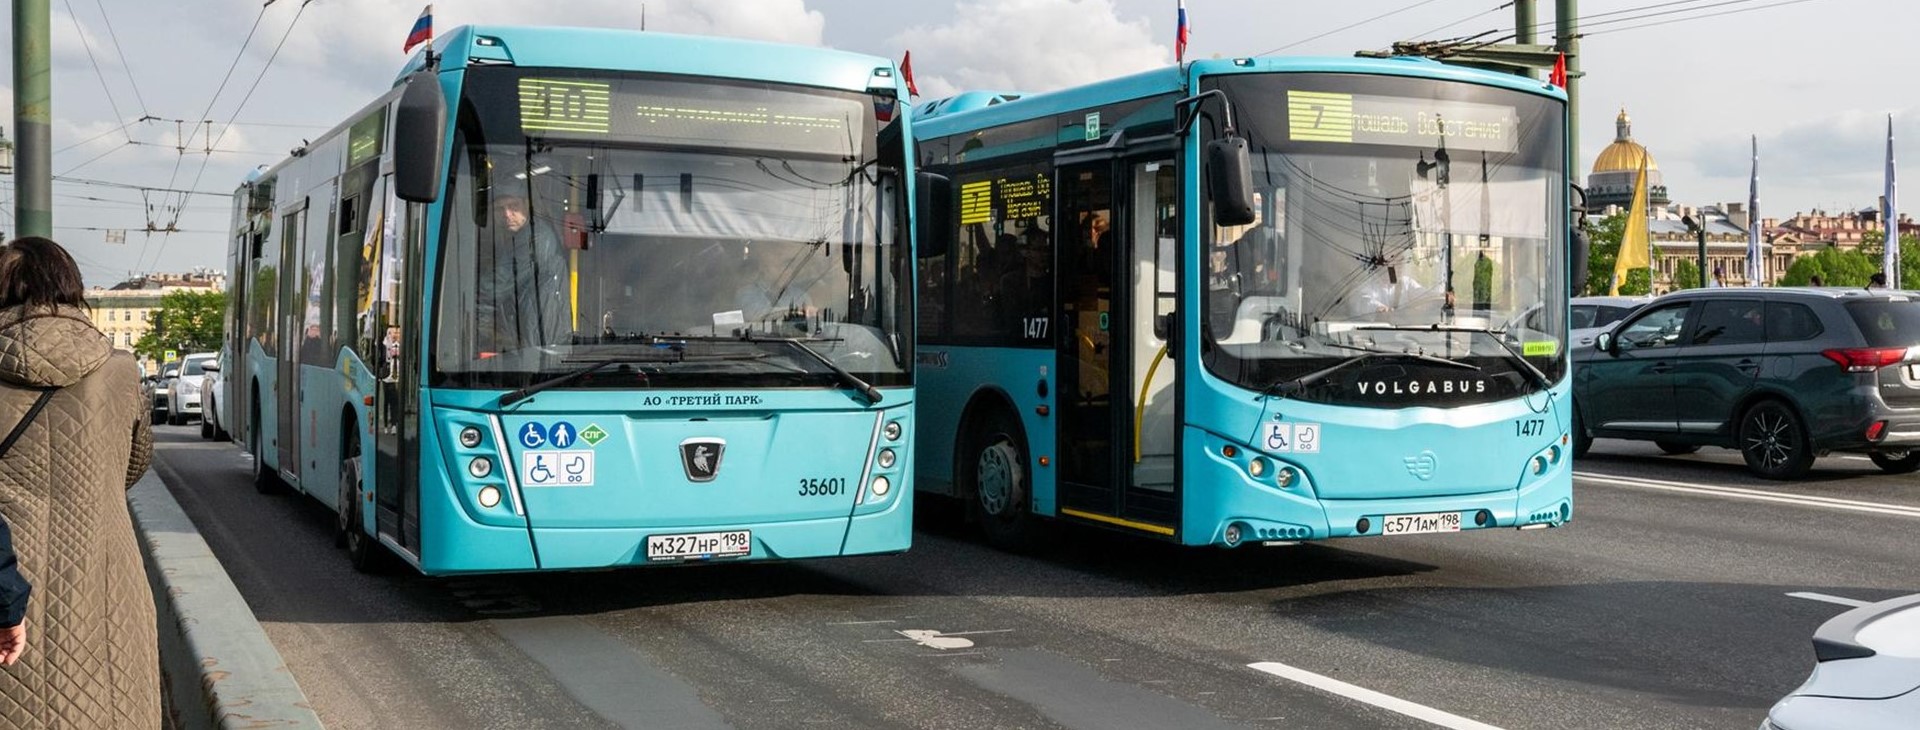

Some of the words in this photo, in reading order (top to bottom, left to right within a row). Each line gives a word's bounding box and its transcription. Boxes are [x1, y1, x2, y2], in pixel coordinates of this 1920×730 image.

[1023, 317, 1049, 339] 1477
[1357, 380, 1486, 394] VOLGABUS
[643, 396, 662, 406] АО
[665, 393, 722, 406] «ТРЕТИЙ
[725, 395, 764, 406] ПАРК»
[1514, 419, 1545, 437] 1477
[798, 477, 845, 496] 35601
[1440, 513, 1459, 526] 198
[722, 532, 747, 546] 198
